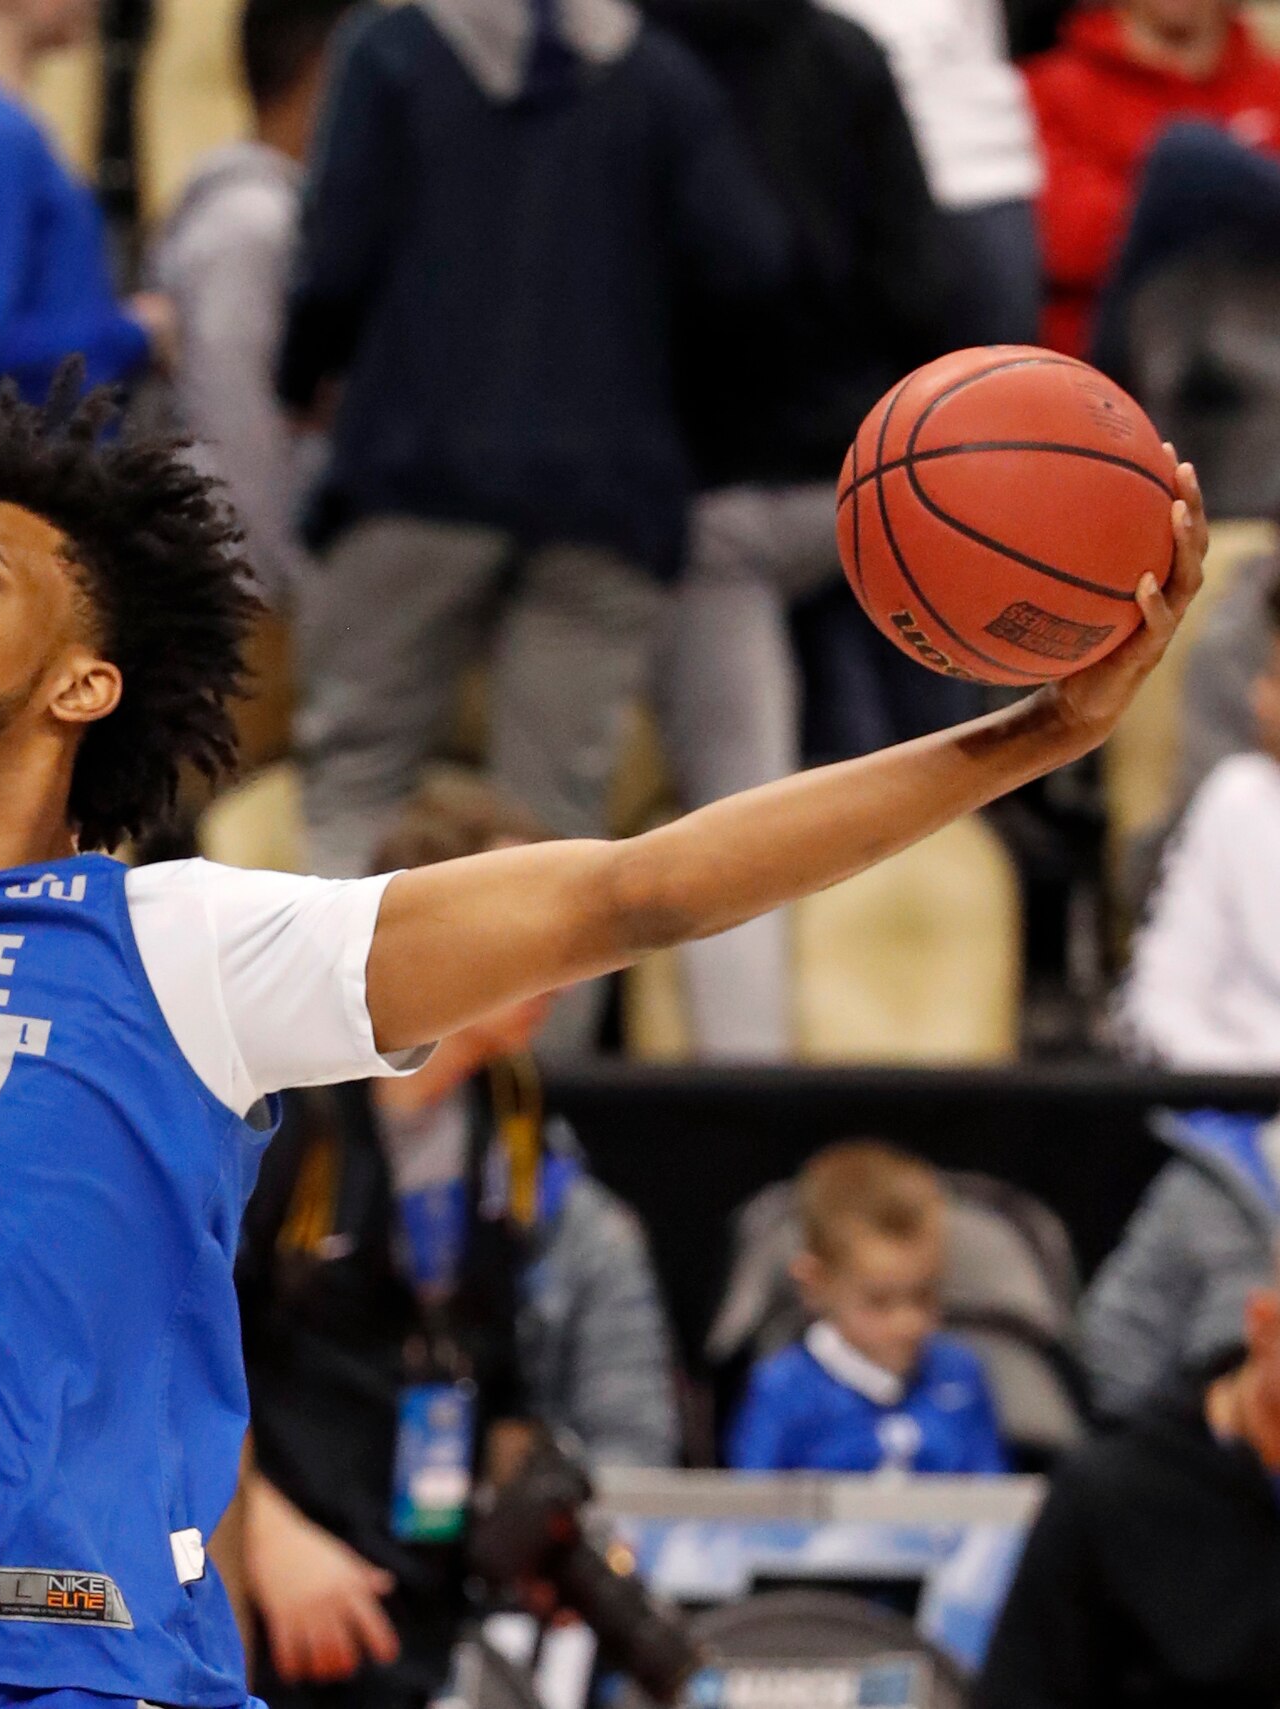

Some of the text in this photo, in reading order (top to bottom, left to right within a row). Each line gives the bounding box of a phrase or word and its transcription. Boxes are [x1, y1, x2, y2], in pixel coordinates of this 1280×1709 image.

[15, 1579, 31, 1598] L
[48, 1576, 105, 1594] NIKE
[47, 1591, 105, 1610] ELITE
